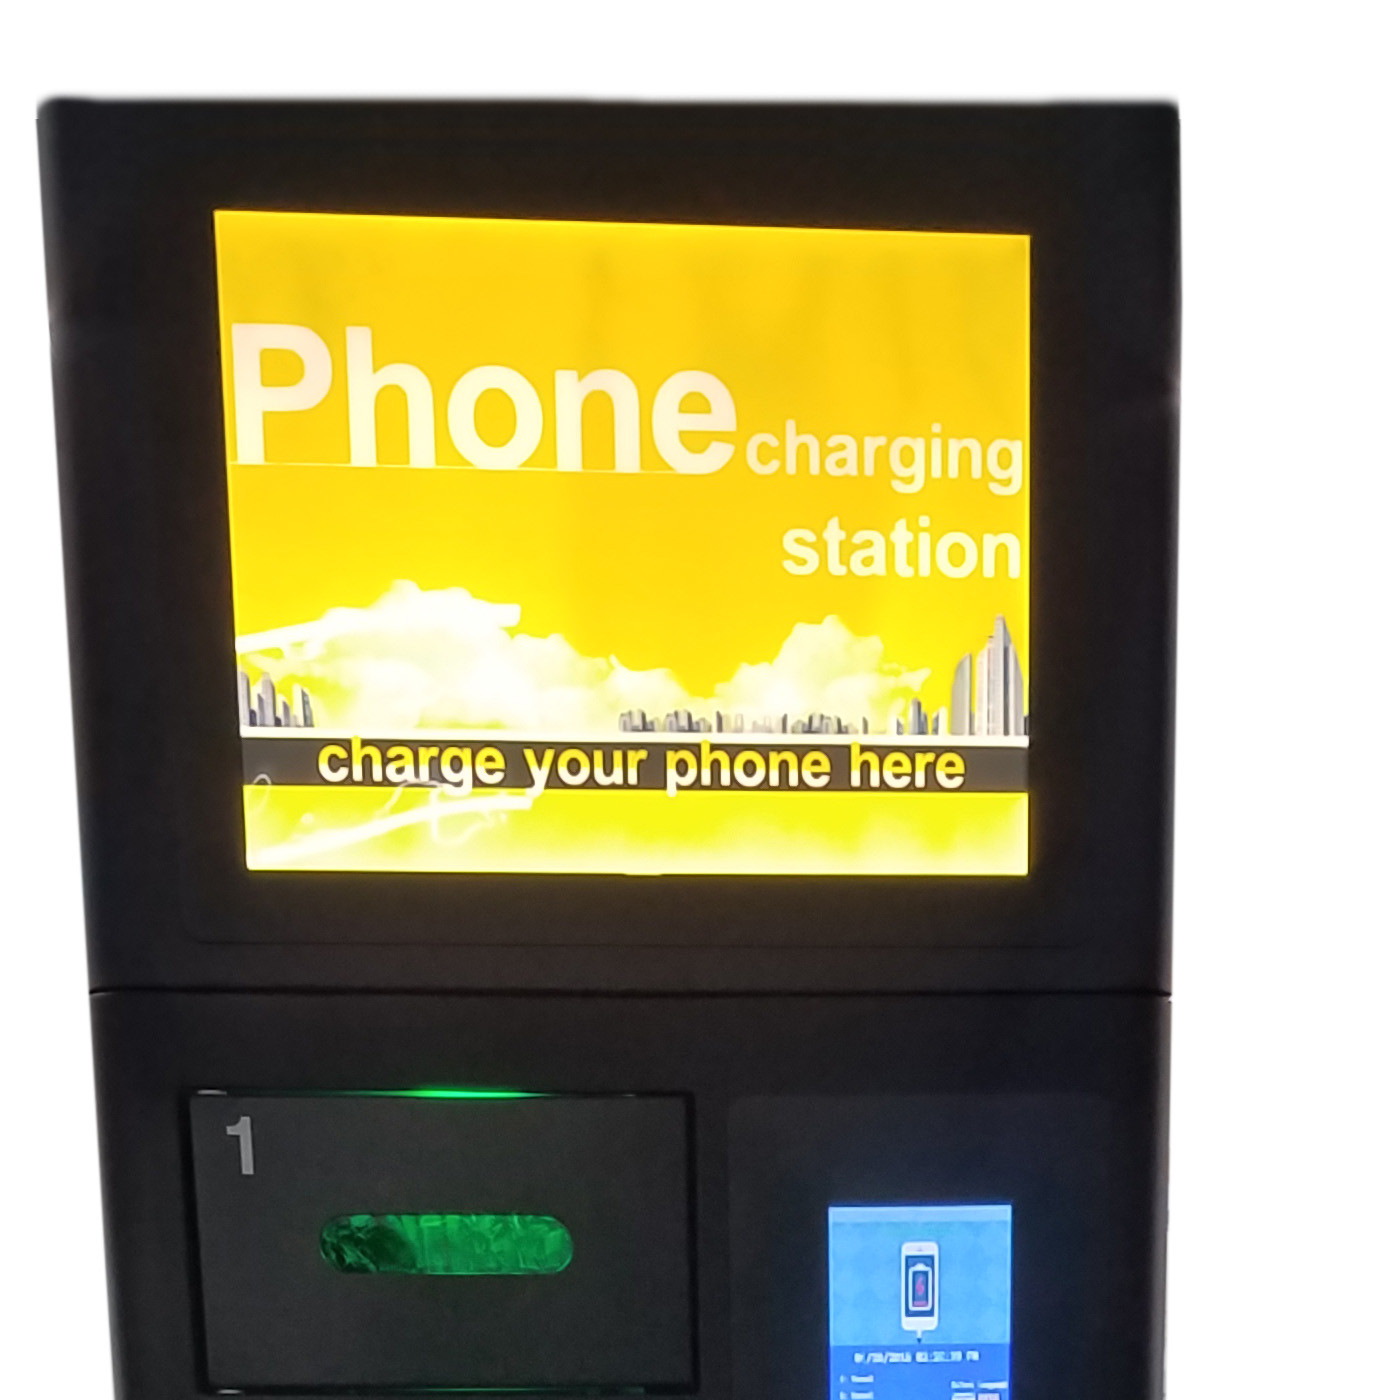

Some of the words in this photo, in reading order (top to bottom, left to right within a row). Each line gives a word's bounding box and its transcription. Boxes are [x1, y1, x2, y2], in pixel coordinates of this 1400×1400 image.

[231, 322, 737, 475] Phone
[746, 419, 1023, 495] charging
[782, 515, 1021, 579] station
[318, 735, 506, 797] charge
[523, 748, 648, 798] your
[666, 740, 831, 797] phone
[850, 741, 965, 789] here
[225, 1116, 255, 1176] 1
